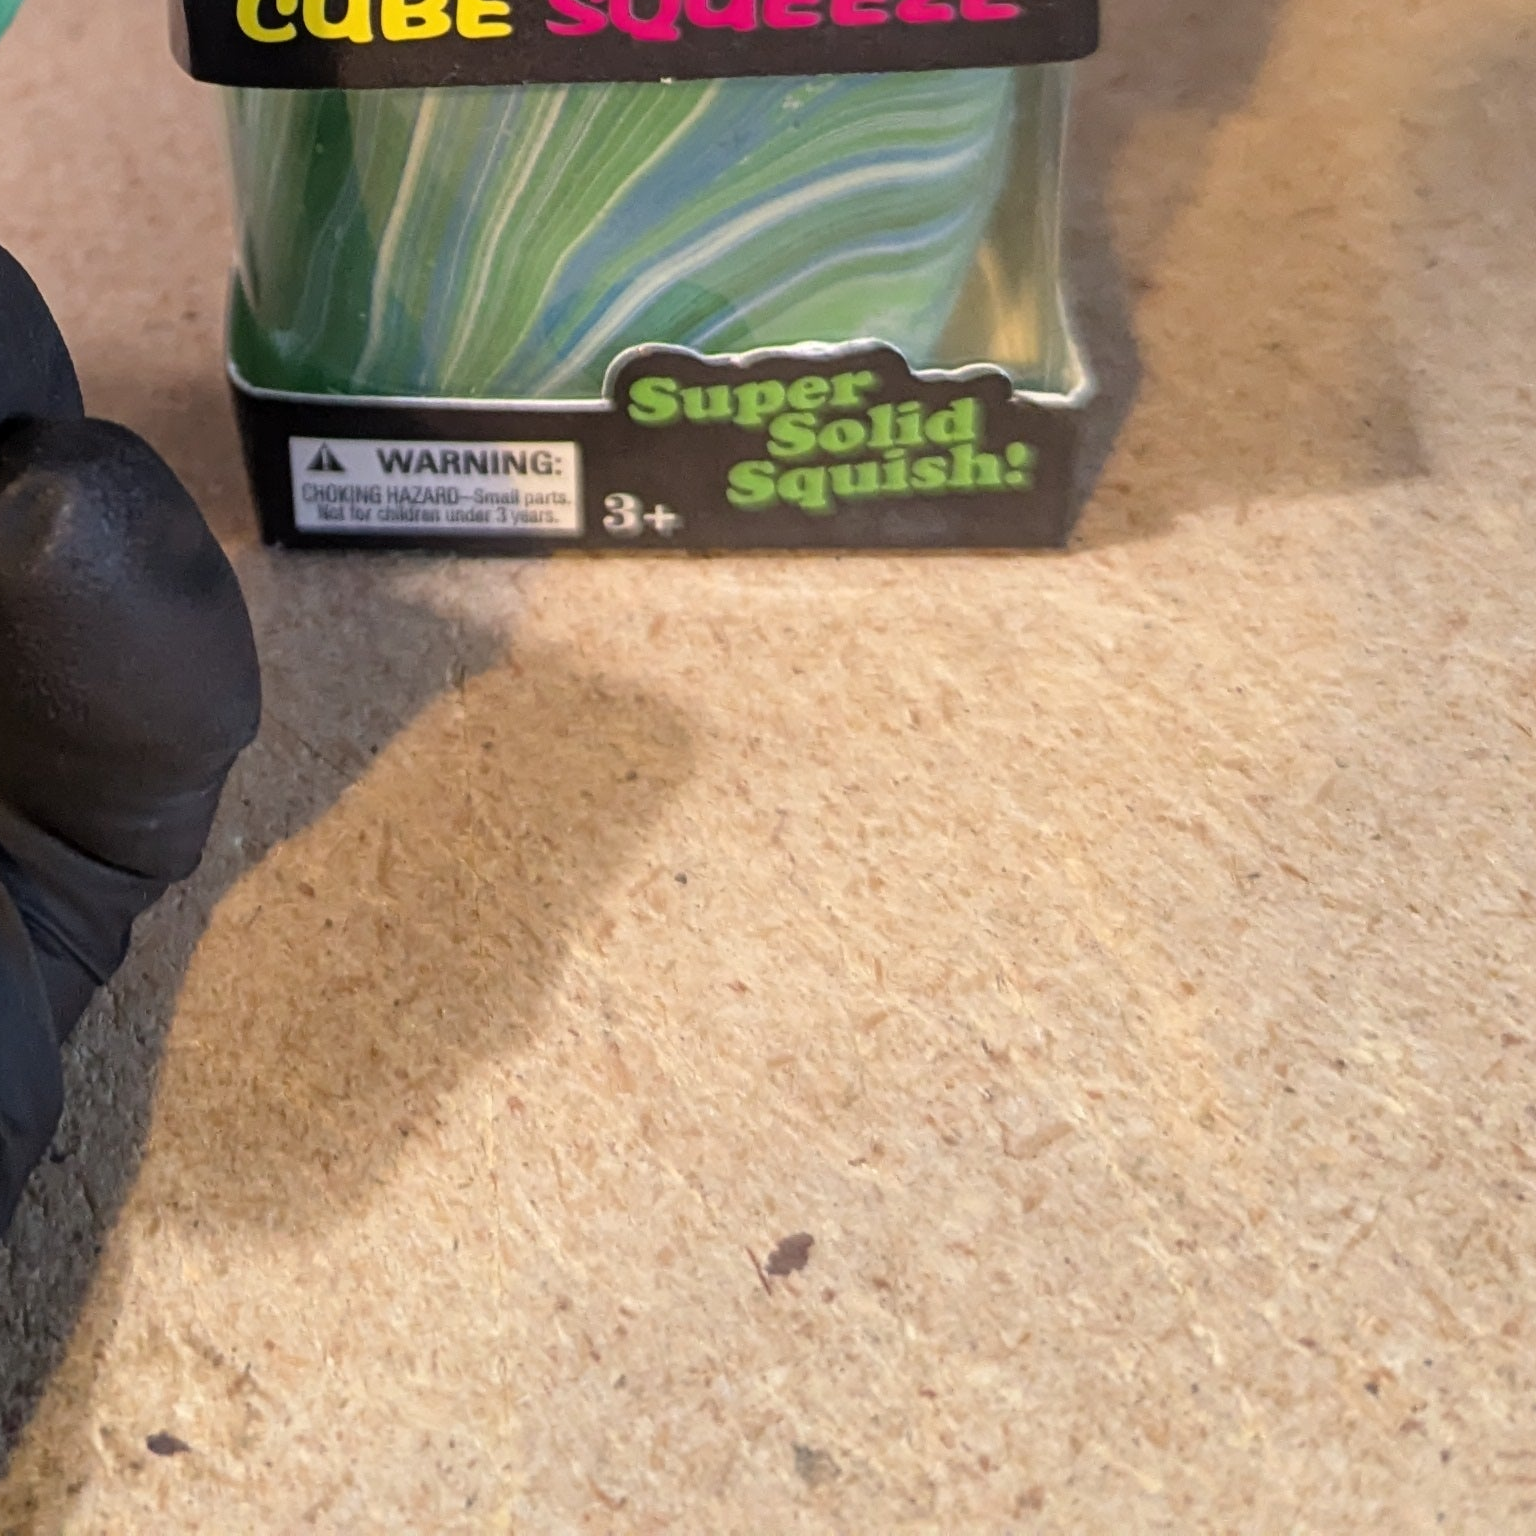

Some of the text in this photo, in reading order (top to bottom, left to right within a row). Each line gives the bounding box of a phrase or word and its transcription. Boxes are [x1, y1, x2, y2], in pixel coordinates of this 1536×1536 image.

[627, 369, 878, 428] Super
[767, 397, 979, 460] Solid
[376, 447, 564, 477] WARNING:
[725, 440, 1034, 514] Squish!
[301, 482, 383, 505] CHOKING
[524, 491, 572, 508] parts.
[375, 505, 441, 524] children
[444, 507, 490, 525] under
[496, 507, 507, 524] 3
[509, 511, 561, 528] years.
[602, 492, 684, 538] 3+
